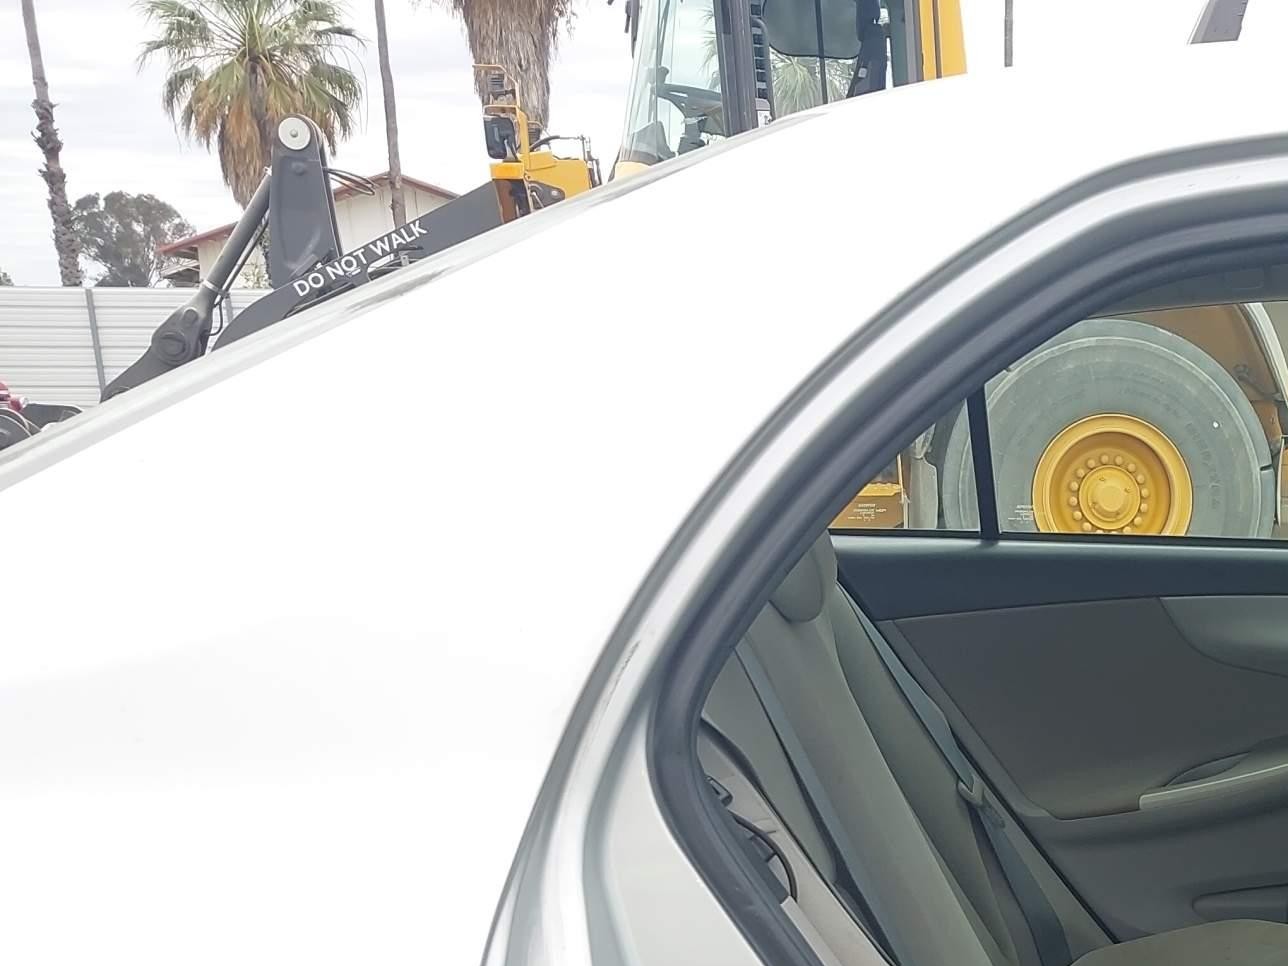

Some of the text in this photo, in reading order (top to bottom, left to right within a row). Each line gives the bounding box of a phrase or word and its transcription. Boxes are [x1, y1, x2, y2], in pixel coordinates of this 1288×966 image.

[293, 220, 428, 296] DO NOT WALK
